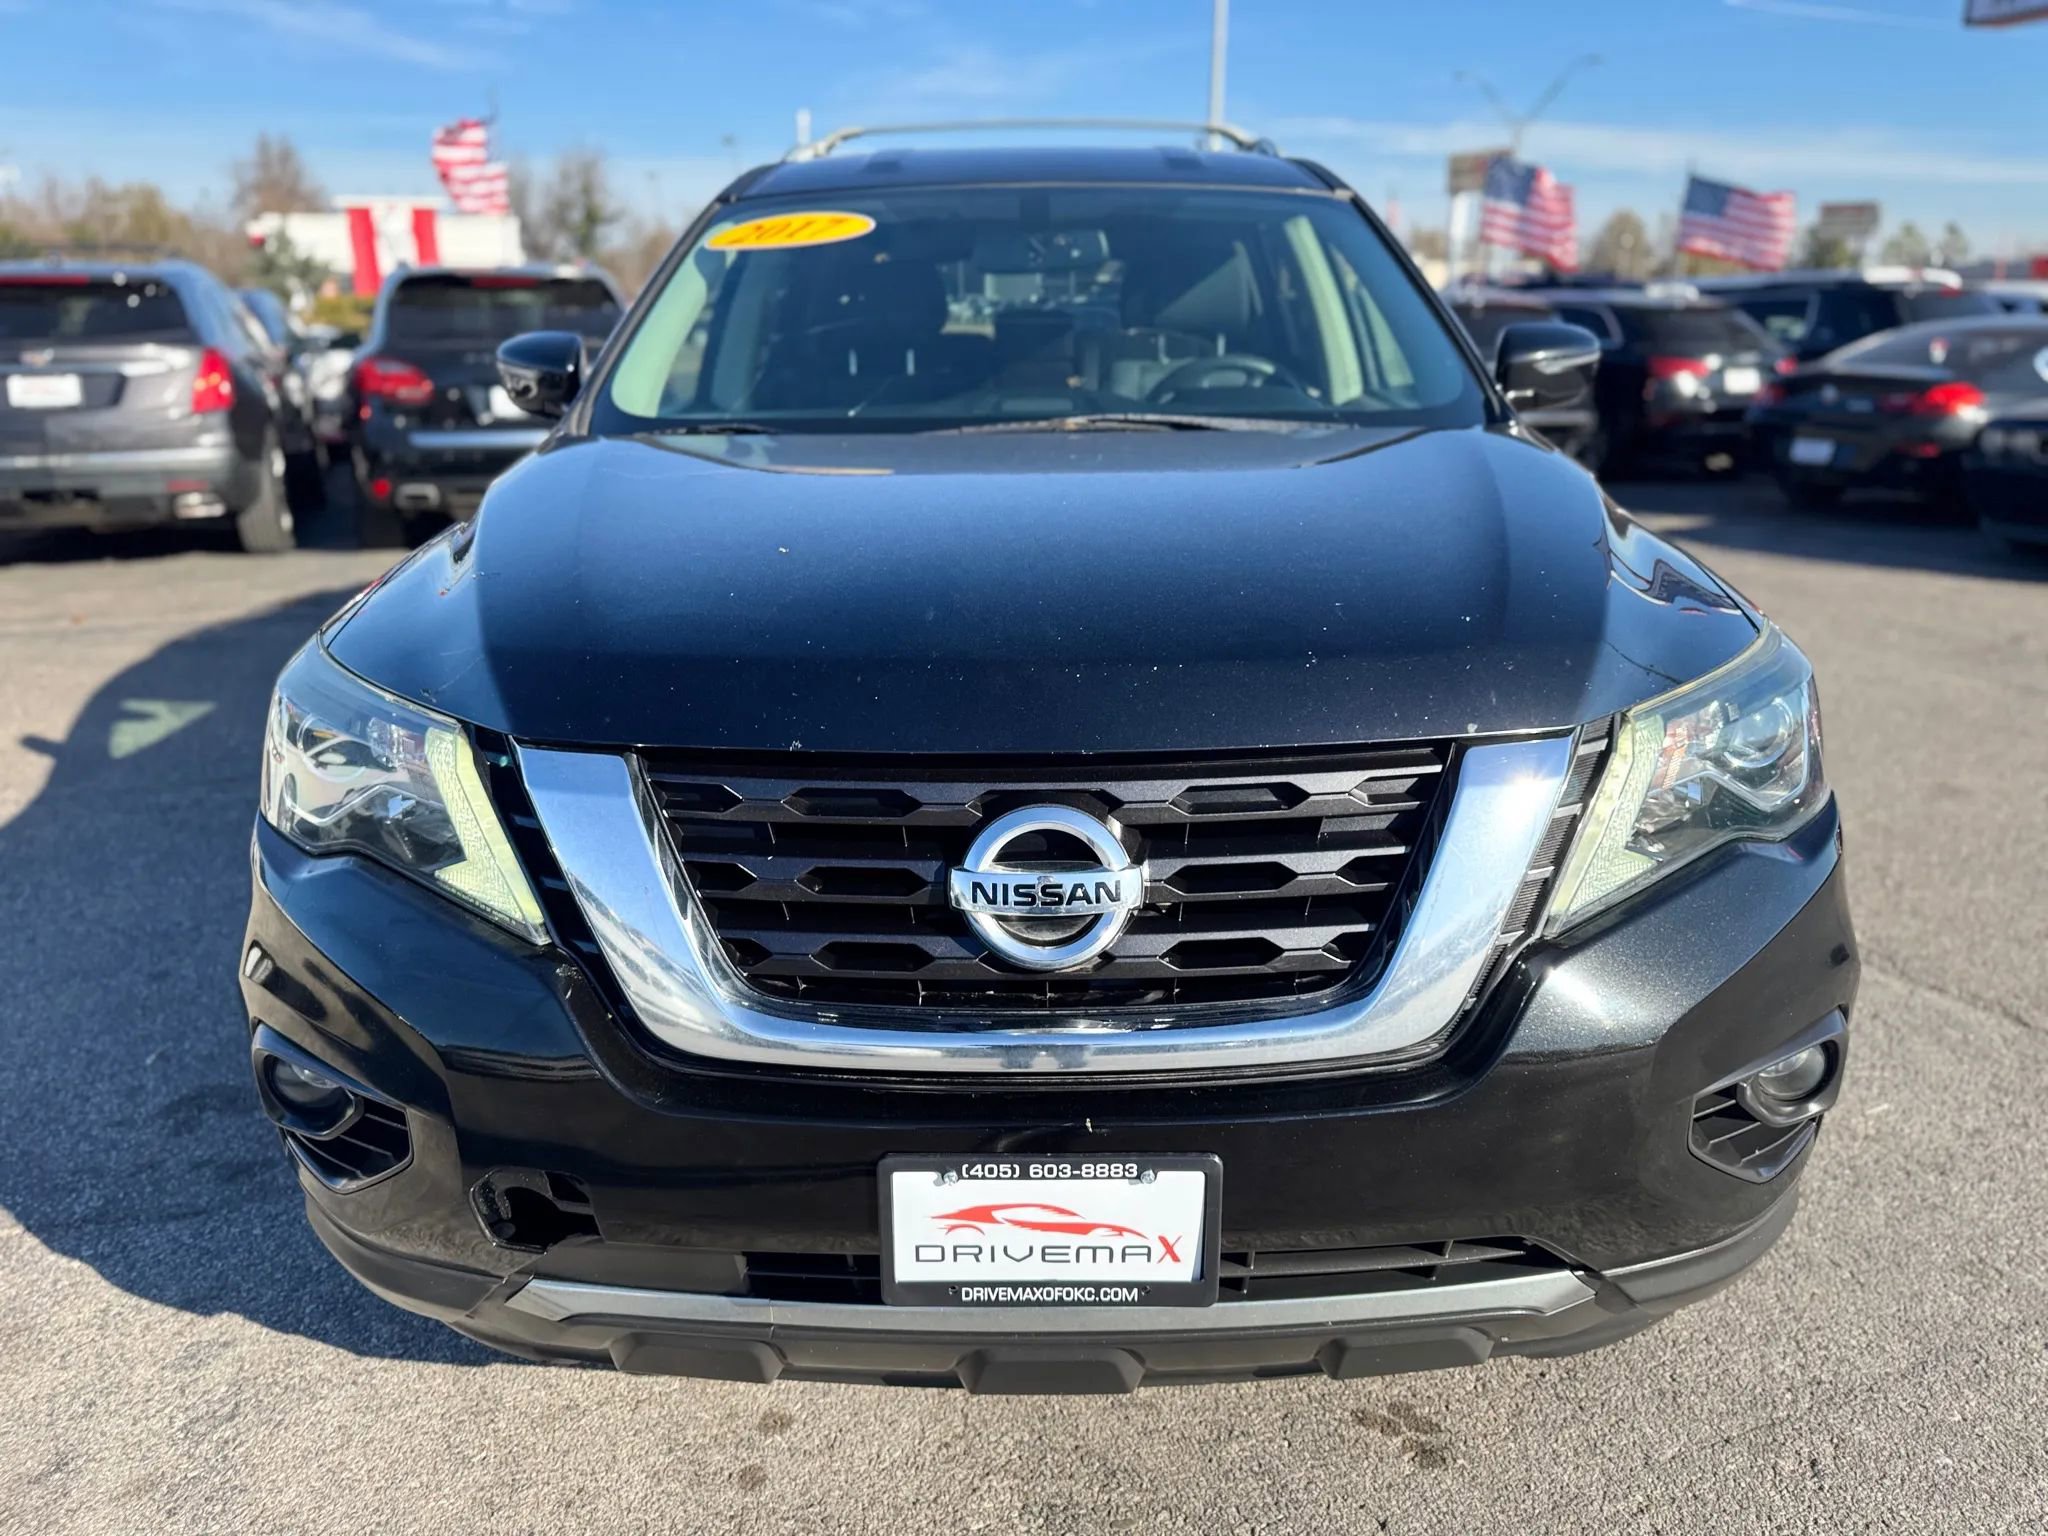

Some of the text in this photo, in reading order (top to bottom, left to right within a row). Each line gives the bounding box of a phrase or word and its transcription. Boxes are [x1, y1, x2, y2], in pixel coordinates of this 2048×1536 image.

[971, 880, 1121, 907] NISSAN
[961, 1163, 1139, 1180] (405) 603-8883
[914, 1235, 1183, 1264] DRIVEMAX
[961, 1286, 1139, 1303] DRIVEMAXOFOKC.COM
